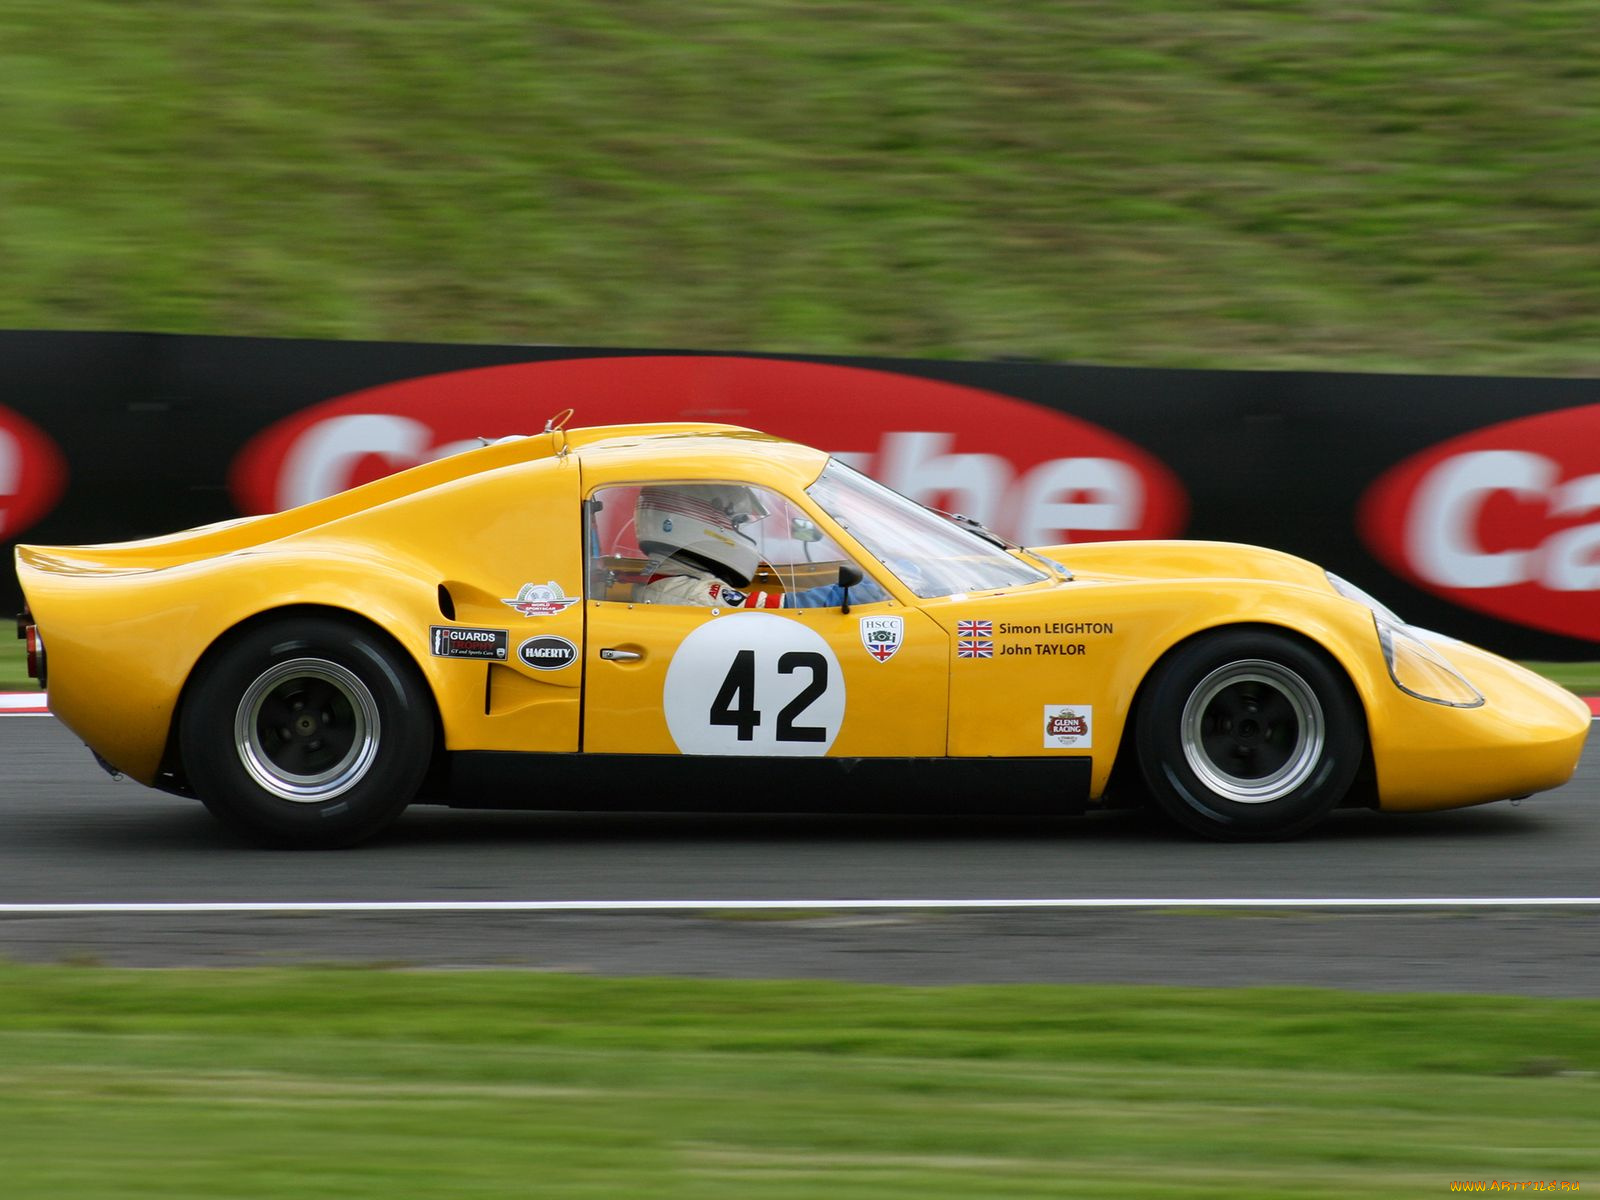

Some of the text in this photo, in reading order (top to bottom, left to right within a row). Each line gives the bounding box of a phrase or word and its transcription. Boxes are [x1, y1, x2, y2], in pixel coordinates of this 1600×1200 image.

[866, 620, 898, 628] HSCC
[999, 623, 1113, 634] Simon LEIGHTON
[450, 631, 496, 642] GUARDS
[451, 641, 495, 650] TROPHY
[1000, 644, 1086, 655] John TAYLOR
[525, 648, 571, 659] HAGERTY
[710, 650, 828, 742] 42
